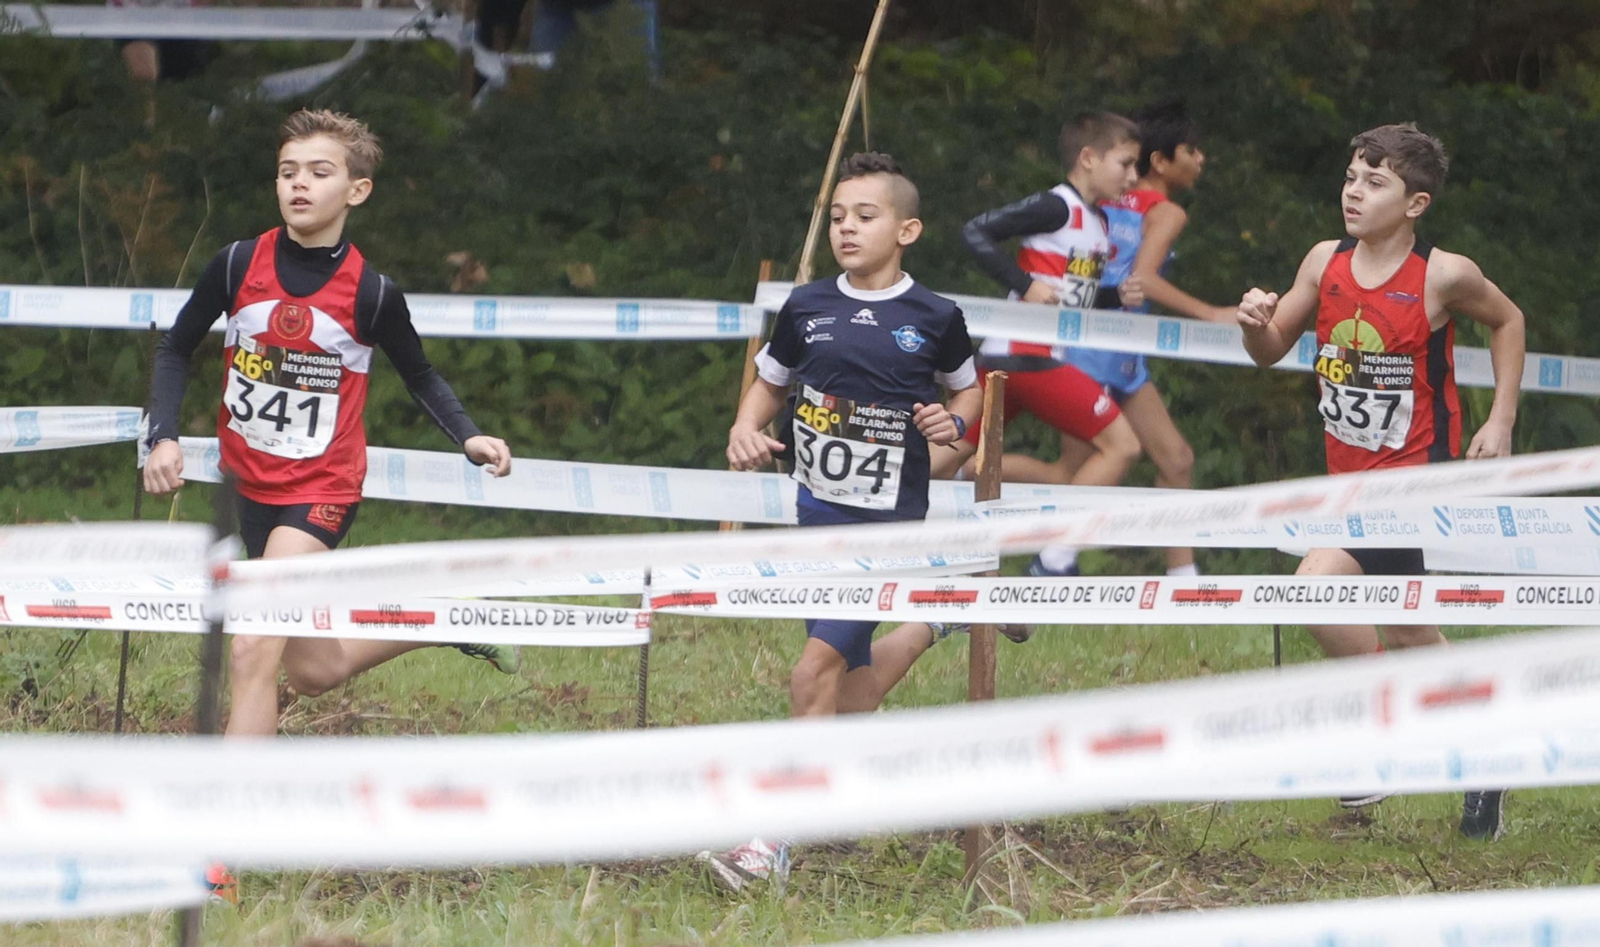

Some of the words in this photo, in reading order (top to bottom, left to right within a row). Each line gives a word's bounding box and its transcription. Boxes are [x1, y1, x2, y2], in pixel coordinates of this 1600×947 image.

[287, 353, 342, 366] MEMORIAL
[1363, 355, 1414, 364] MEMORIAL
[281, 363, 341, 378] BELARMINO
[1359, 365, 1414, 375] BELARMINO
[295, 376, 338, 389] ALONSO
[1372, 377, 1411, 385] ALONSO
[231, 376, 321, 438] 341
[1323, 381, 1402, 430] 337
[862, 429, 904, 441] ALONSO
[797, 424, 892, 487] 304
[1364, 510, 1397, 521] XUNTA
[1456, 508, 1496, 520] DEPORTE
[1516, 508, 1550, 520] XUNTA
[1306, 524, 1343, 535] GALEGO
[1365, 523, 1381, 535] DE
[1383, 522, 1421, 535] GALICIA
[1459, 523, 1496, 534] GALEGO
[1519, 523, 1531, 534] DE
[1534, 522, 1573, 534] GALICIA
[728, 588, 808, 605] CONCELLO
[812, 588, 833, 604] DE
[838, 587, 873, 604] VIGO
[989, 586, 1068, 603] CONCELLO
[1072, 586, 1094, 603] DE
[1100, 586, 1135, 602] VIGO
[1253, 586, 1333, 603] CONCELLO
[1338, 586, 1358, 603] DE
[1364, 586, 1399, 603] VIGO
[1516, 586, 1595, 603] CONCELLO
[124, 602, 211, 622] CONCELL
[450, 607, 548, 626] CONCELLO
[553, 611, 577, 626] DE
[584, 610, 629, 625] VIGO
